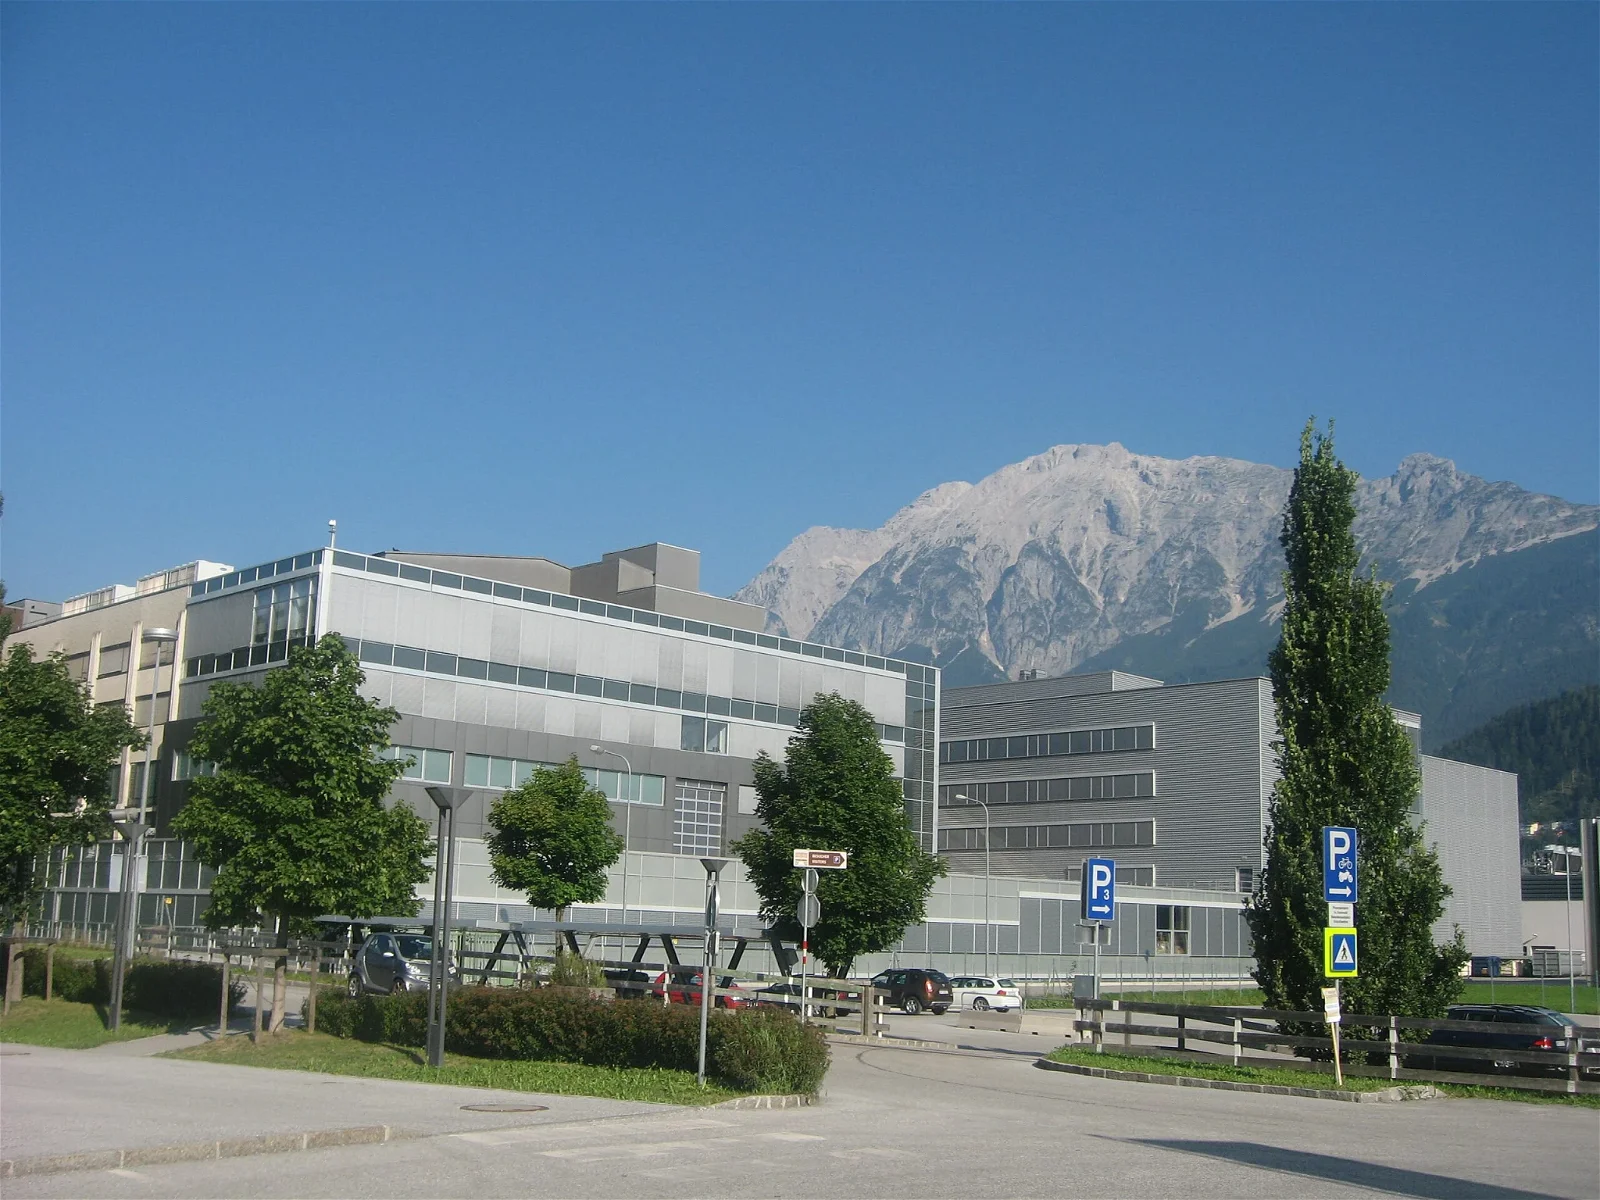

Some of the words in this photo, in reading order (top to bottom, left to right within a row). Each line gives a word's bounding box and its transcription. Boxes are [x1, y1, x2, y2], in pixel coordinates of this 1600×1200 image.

[1330, 831, 1350, 870] P
[1092, 865, 1111, 899] P
[1103, 889, 1110, 900] 3
